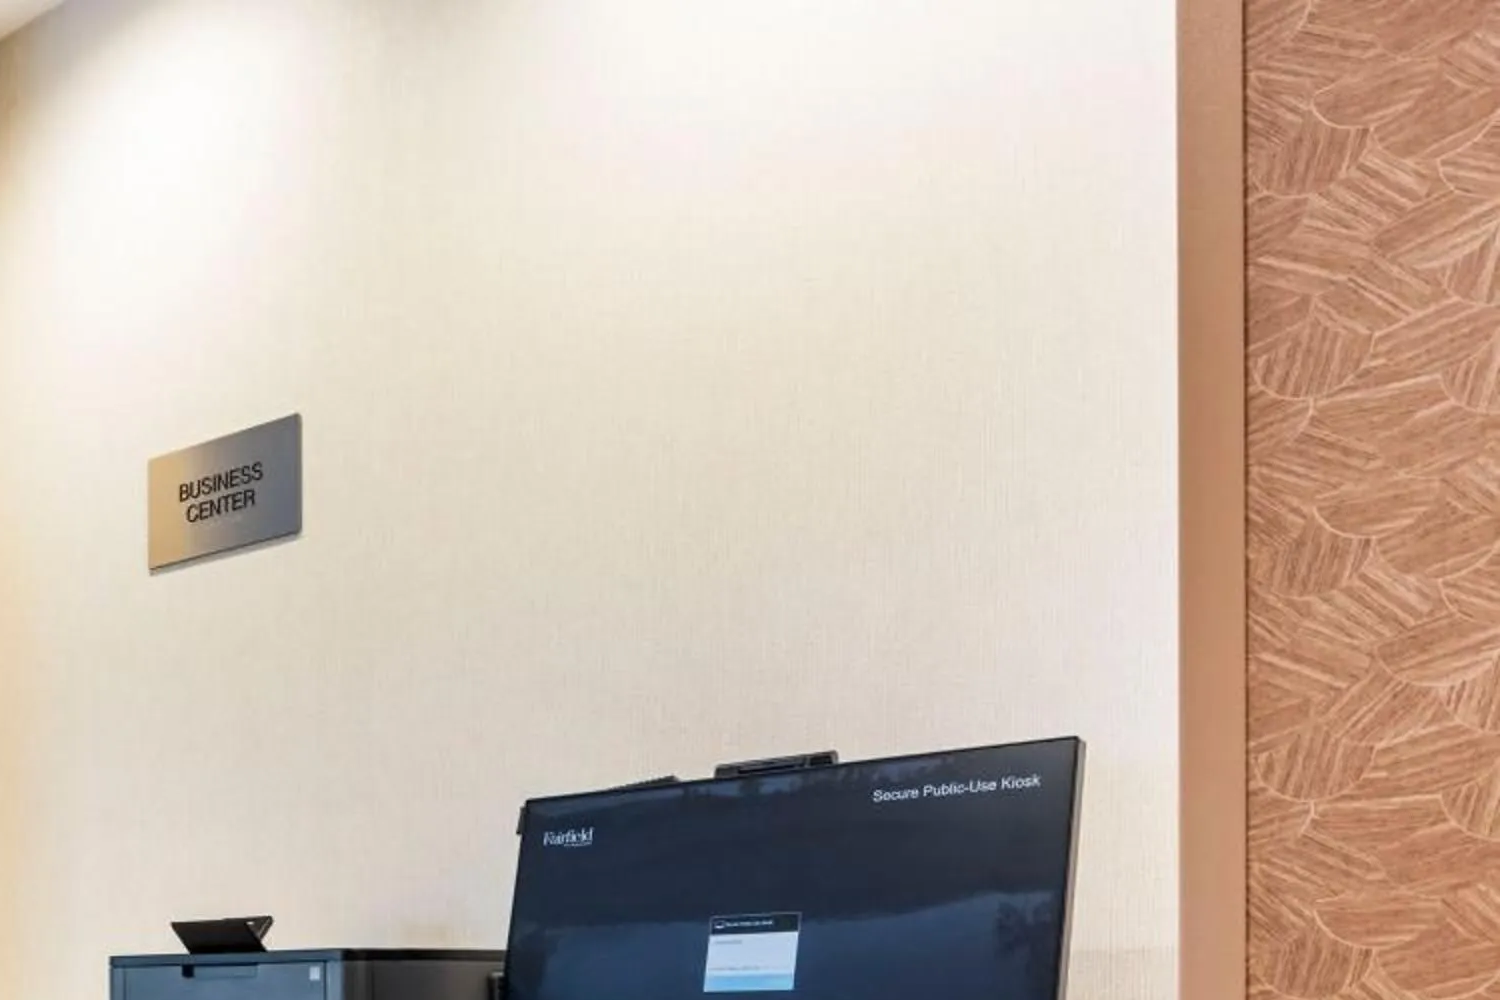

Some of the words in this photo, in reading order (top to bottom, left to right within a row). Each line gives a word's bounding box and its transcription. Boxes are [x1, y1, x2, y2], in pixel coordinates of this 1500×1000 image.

[179, 461, 264, 502] BUSINESS
[186, 489, 256, 523] CENTER
[872, 786, 919, 802] Secure
[923, 778, 997, 797] Public-Use
[1001, 773, 1041, 790] Kiosk
[543, 826, 594, 846] Fairfield
